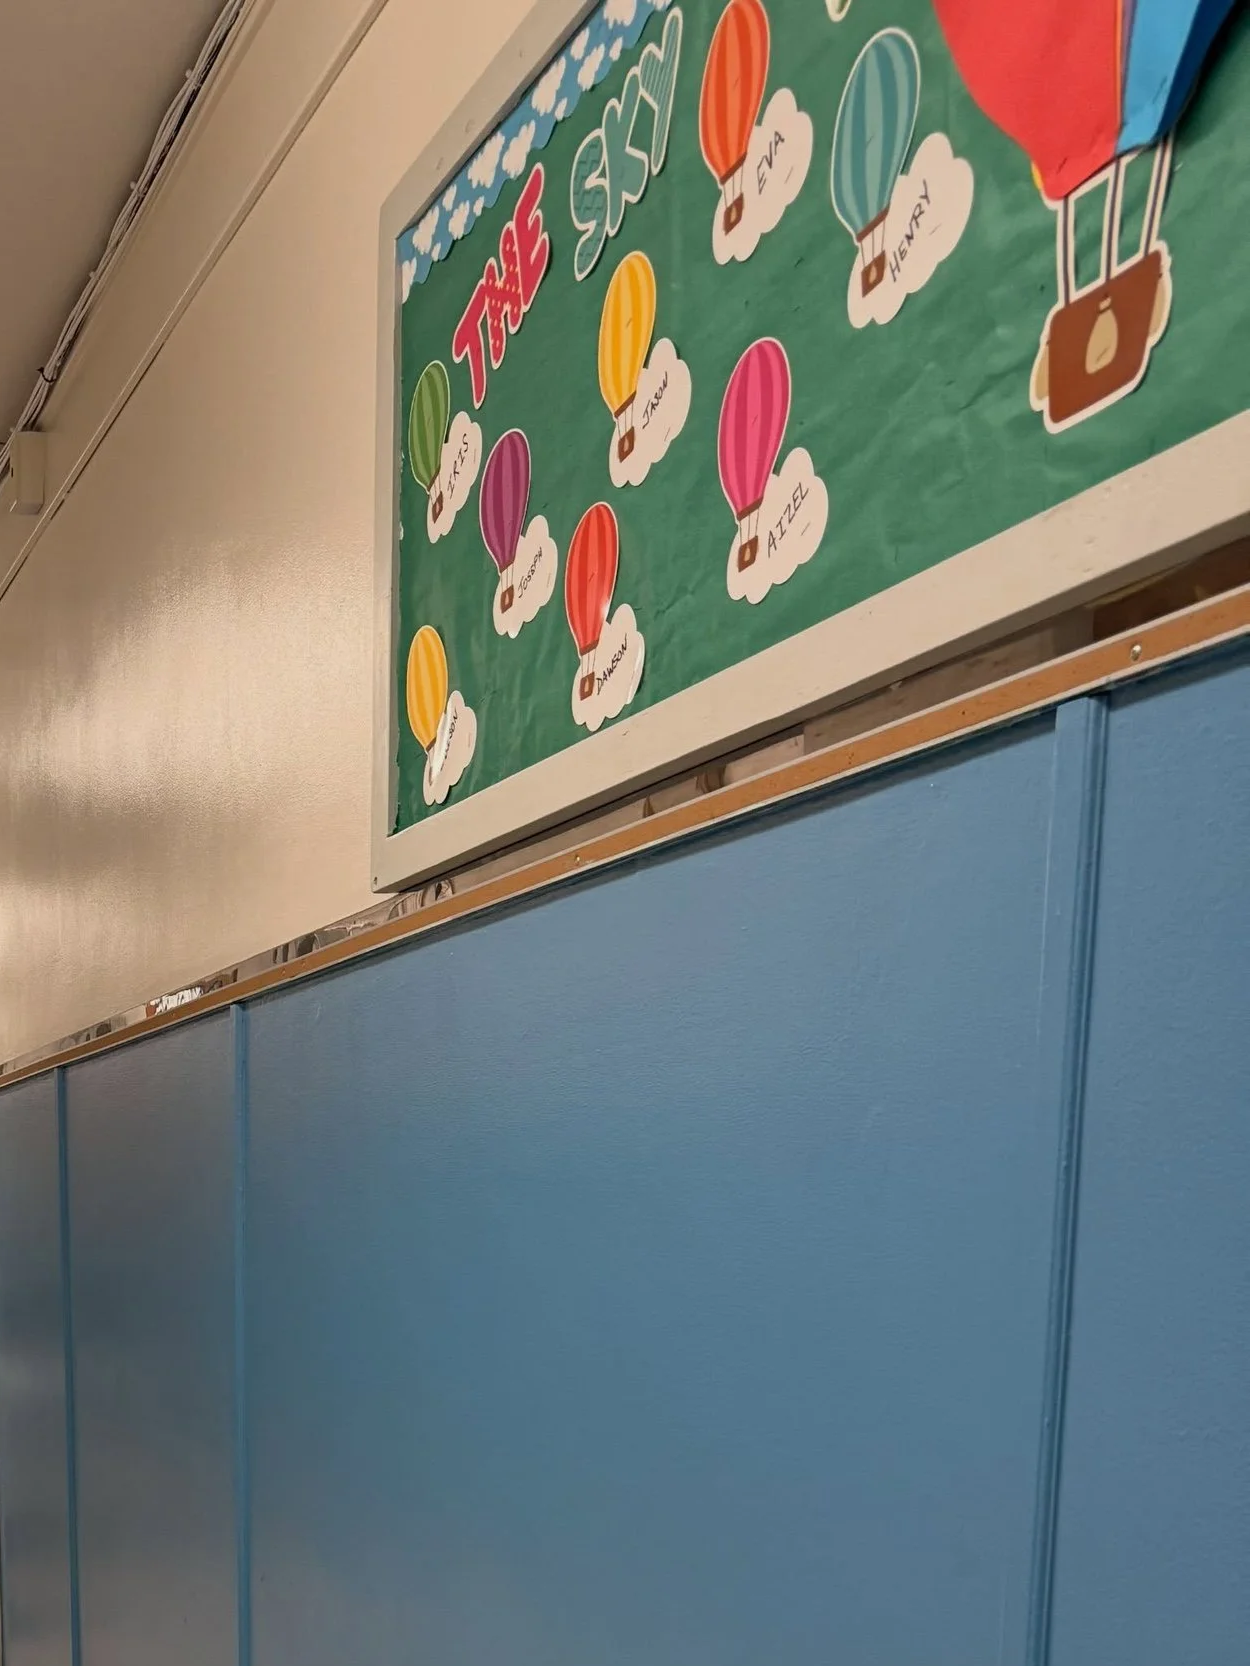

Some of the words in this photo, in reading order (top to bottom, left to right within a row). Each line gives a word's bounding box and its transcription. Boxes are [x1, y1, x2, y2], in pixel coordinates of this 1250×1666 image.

[756, 130, 786, 196] EVA
[452, 162, 549, 410] THE
[570, 6, 683, 282] SKY
[889, 178, 932, 283] HENRY
[642, 371, 669, 430] JASON
[446, 432, 470, 500] IRIS
[767, 482, 810, 559] AIZEL
[595, 632, 629, 696] DAWSON
